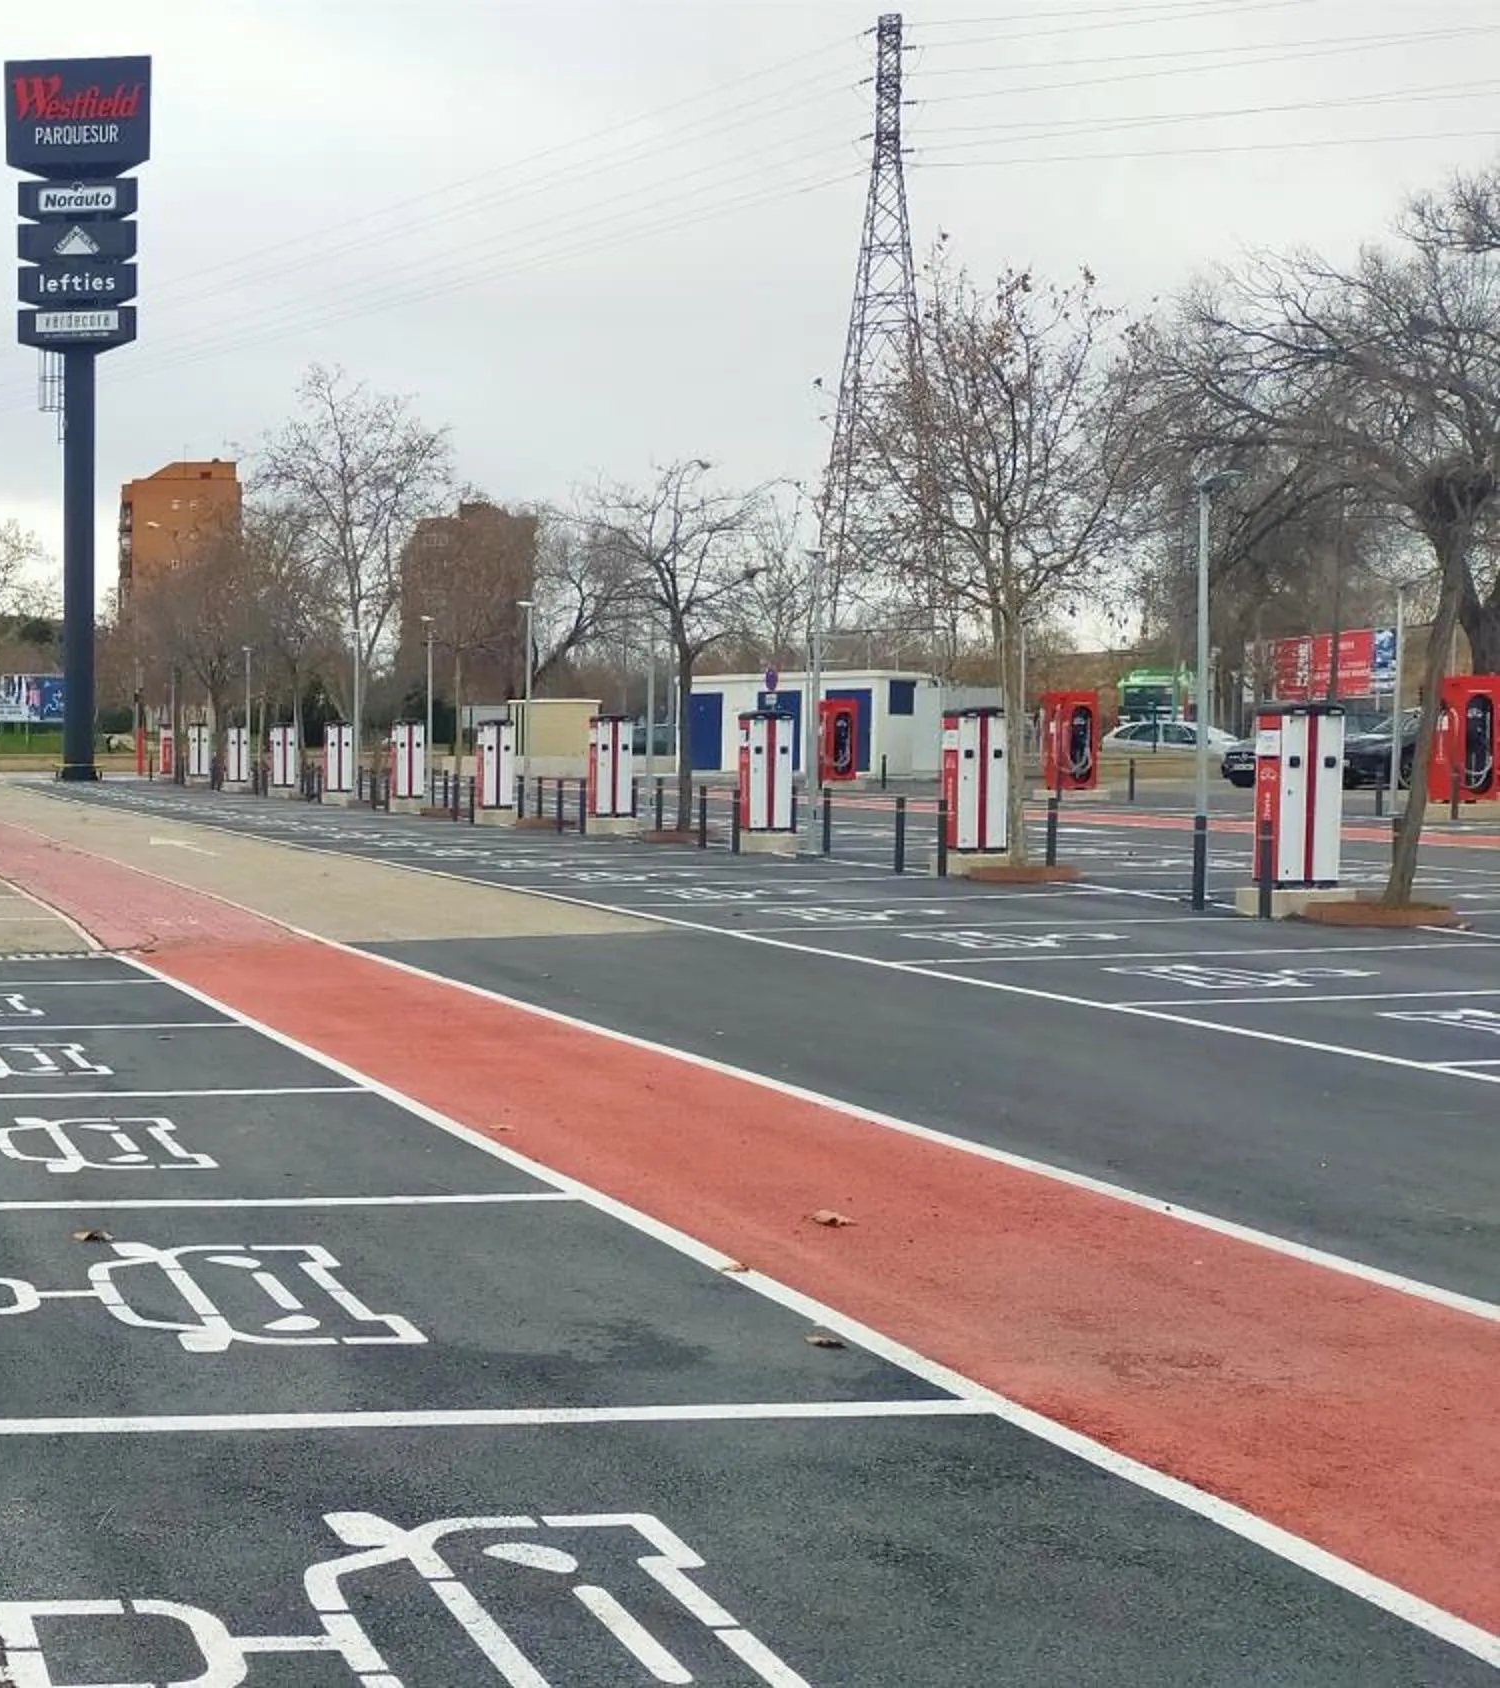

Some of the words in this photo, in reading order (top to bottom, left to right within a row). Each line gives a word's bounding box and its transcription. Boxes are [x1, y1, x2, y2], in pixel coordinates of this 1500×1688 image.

[14, 75, 144, 121] Westfield
[35, 123, 119, 145] PARQUESUR
[44, 192, 112, 209] Norauto
[39, 272, 115, 293] lefties
